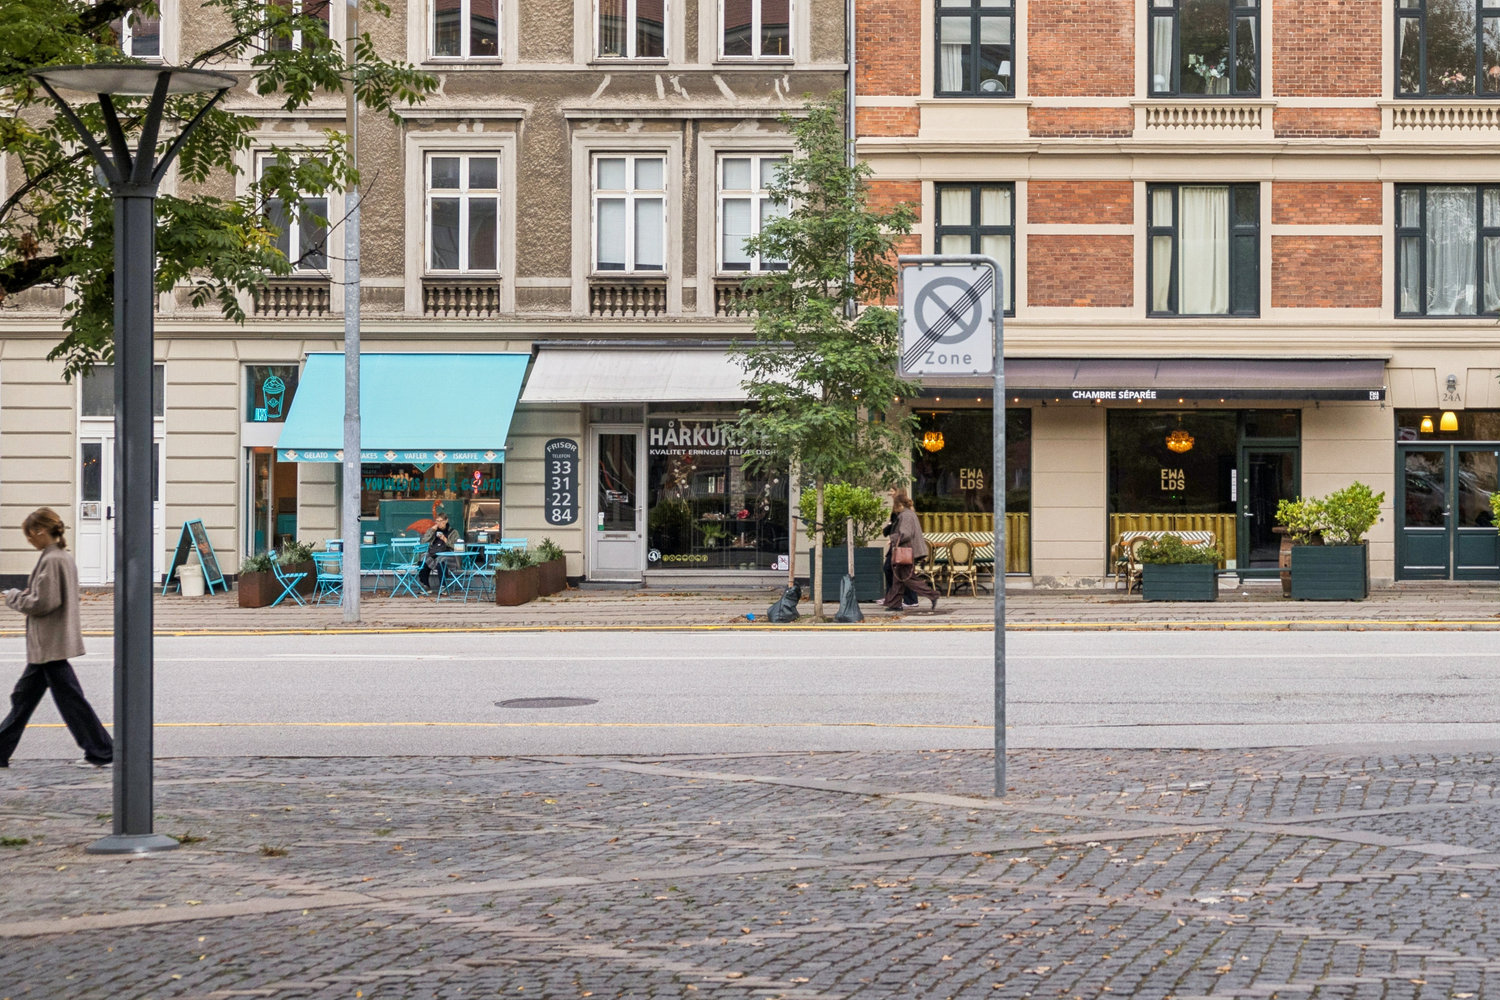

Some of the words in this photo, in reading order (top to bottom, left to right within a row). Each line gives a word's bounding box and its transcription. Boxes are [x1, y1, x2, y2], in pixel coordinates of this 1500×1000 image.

[925, 351, 972, 365] Zone
[1072, 390, 1116, 399] CHAMBRE
[1118, 389, 1157, 399] SÉPARÉE
[1442, 393, 1461, 401] 24A
[546, 441, 577, 453] FRISØR
[304, 451, 328, 460] GELATO
[404, 452, 427, 460] VAFLER
[453, 452, 478, 460] ISKAFFE
[551, 461, 571, 474] 33
[960, 468, 983, 479] EWA
[1161, 468, 1185, 479] EWA
[365, 477, 383, 491] YOU
[551, 476, 570, 490] 31
[960, 479, 984, 490] LDS
[1161, 480, 1185, 490] LDS
[551, 492, 571, 506] 22
[551, 508, 572, 522] 84
